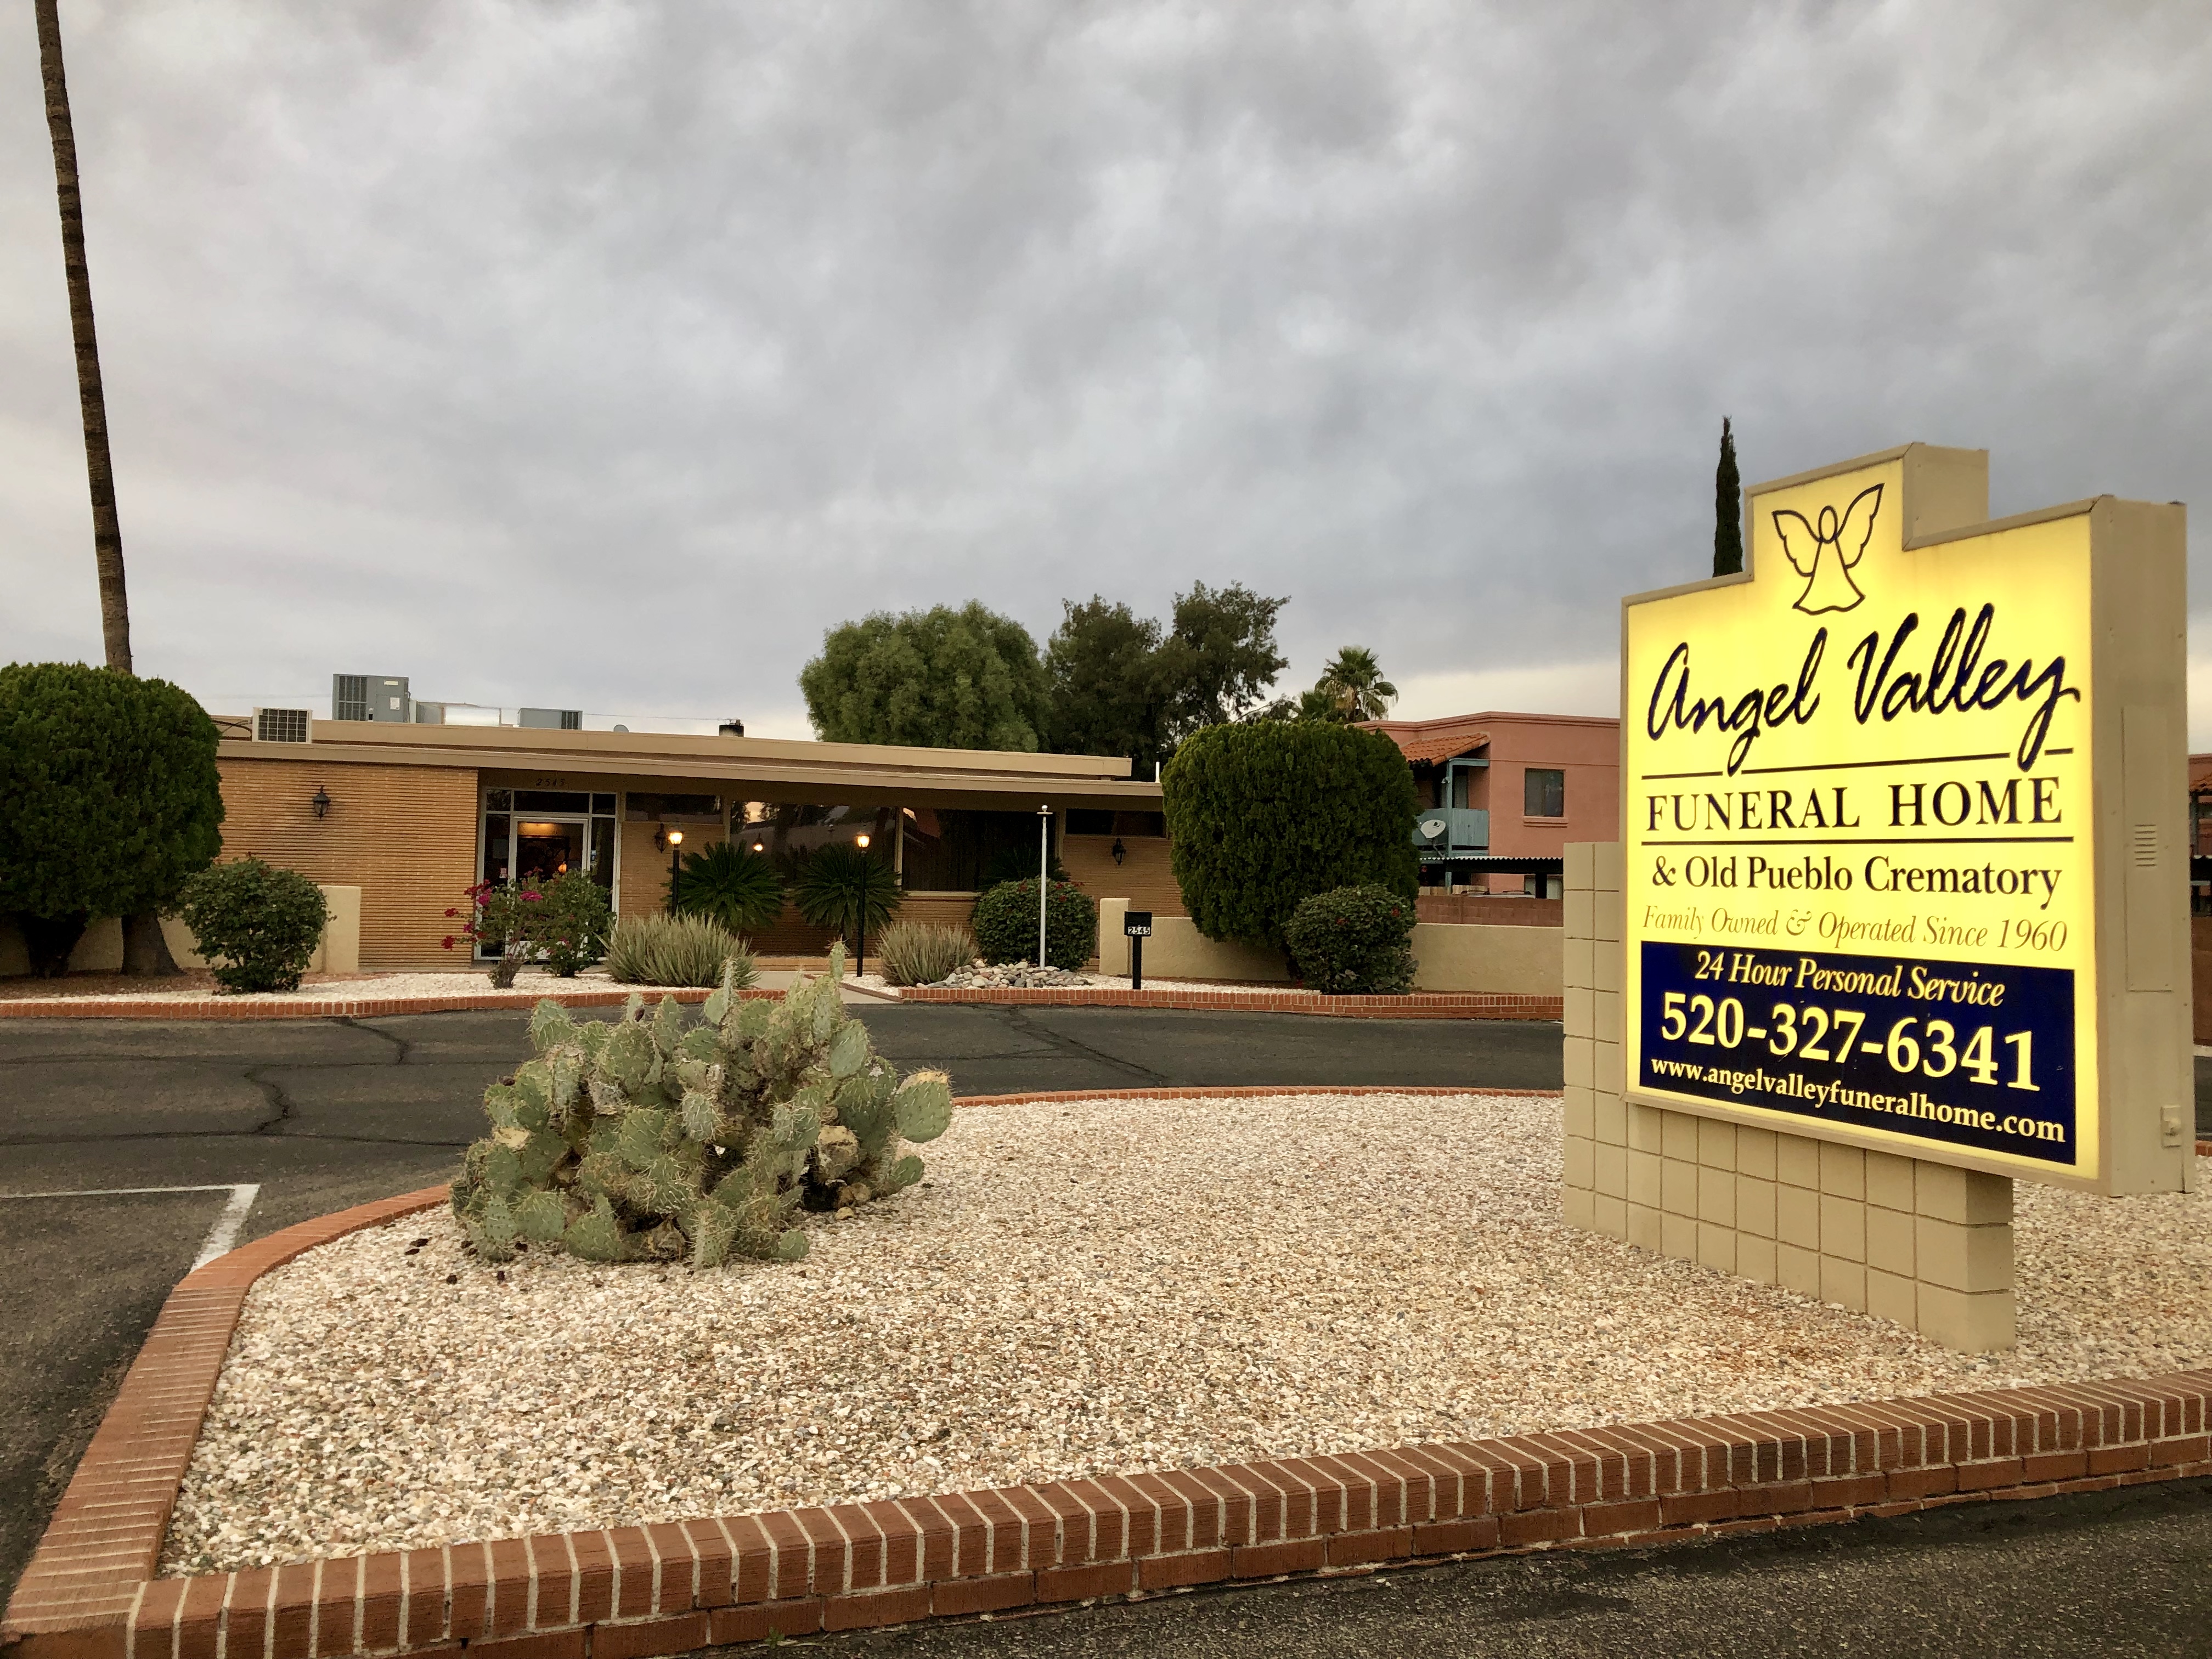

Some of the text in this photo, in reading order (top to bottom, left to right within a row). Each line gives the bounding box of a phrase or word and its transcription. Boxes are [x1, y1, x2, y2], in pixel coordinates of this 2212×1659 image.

[1647, 602, 2080, 776] Angel Valley
[1645, 776, 2063, 832] FUNERAL HOME
[1652, 855, 2063, 911] & Old Pueblo Crematory
[1642, 905, 2068, 952] Family Owned & Operated Since 1960
[1694, 950, 2006, 1007] 24 Hour Personal Service
[1661, 991, 2041, 1092] 520-327-6341
[1650, 1058, 2066, 1143] www.angelvalleyfuneralhome.com
